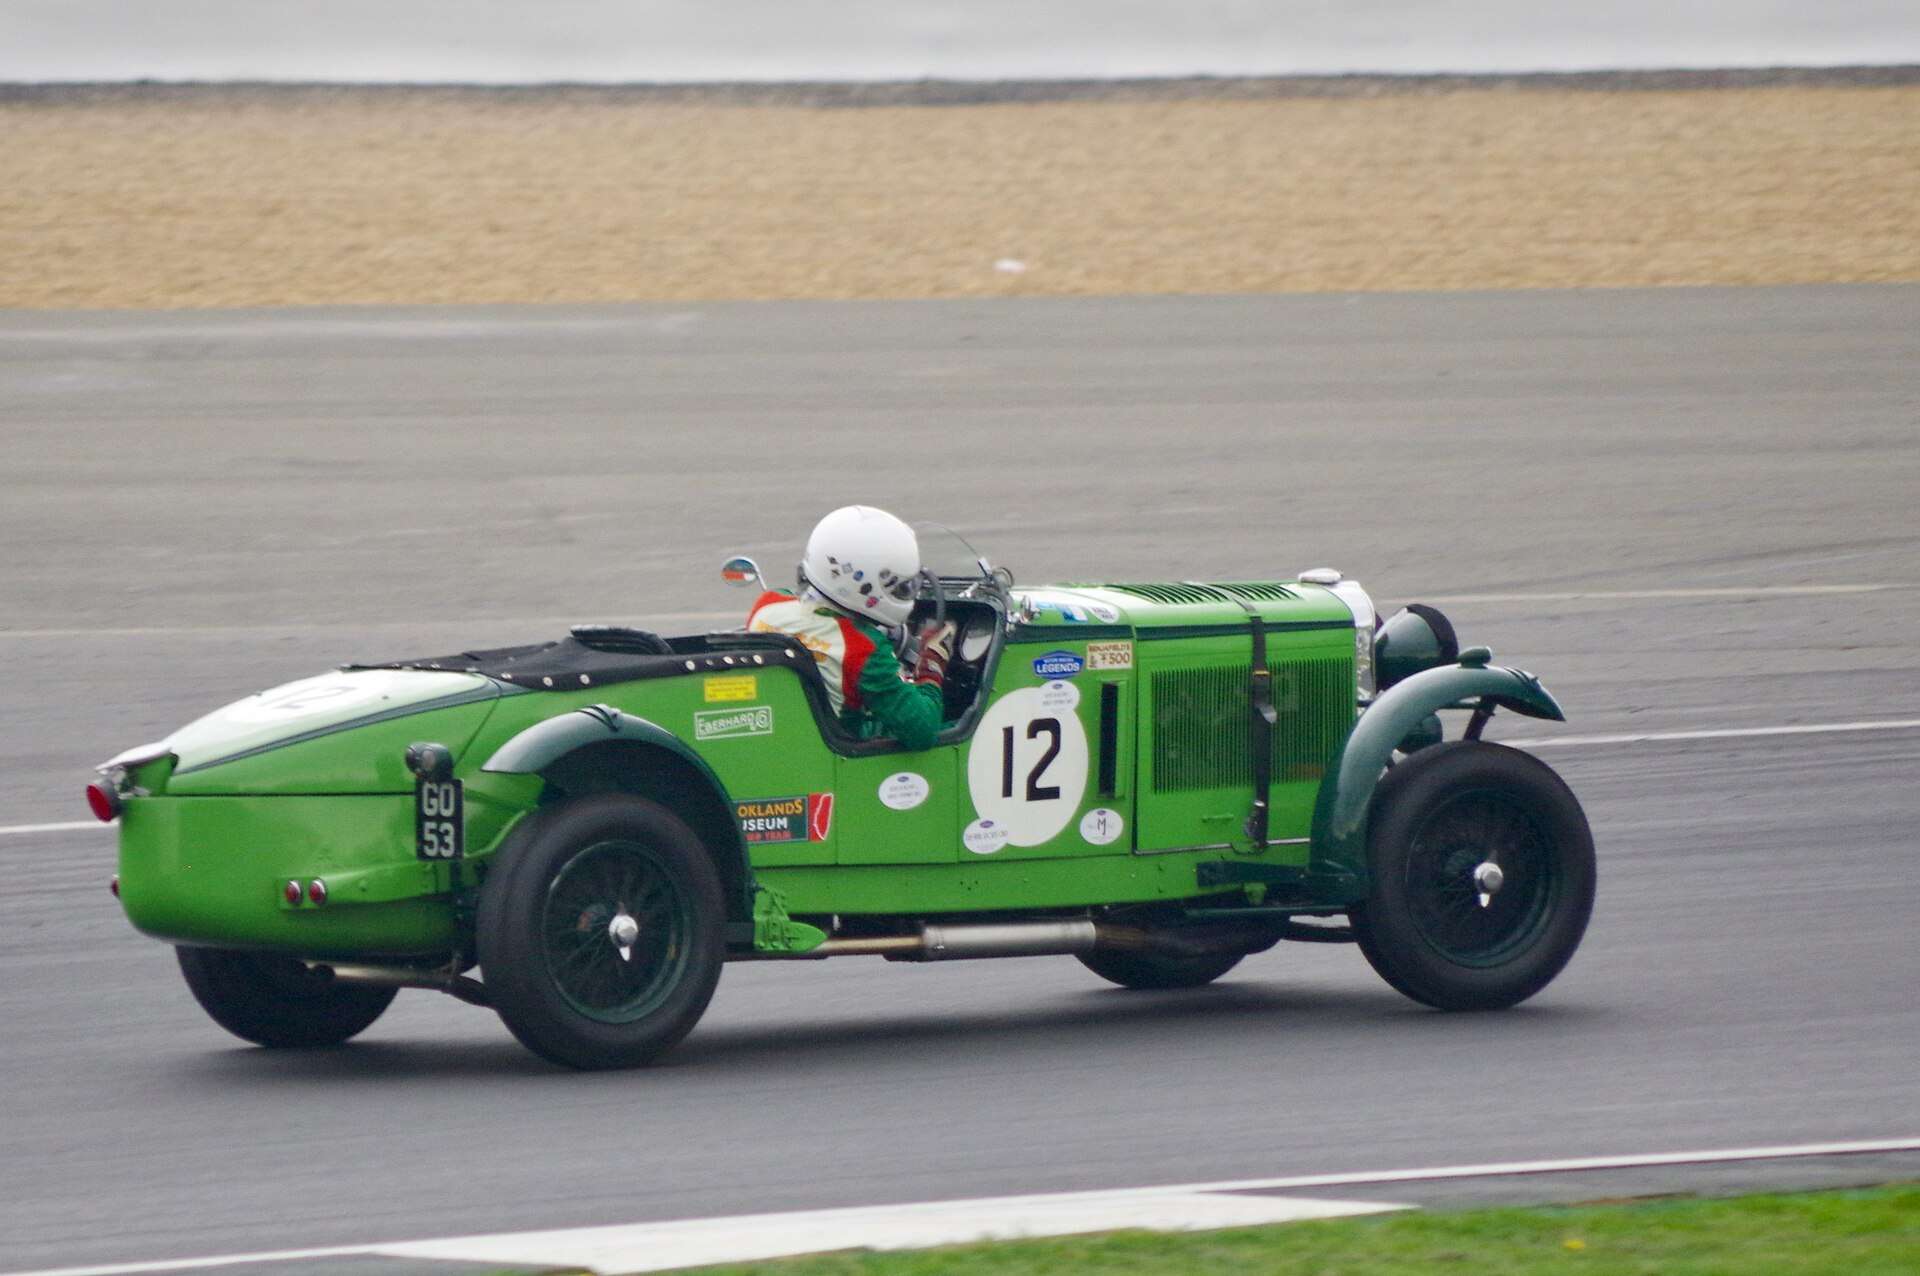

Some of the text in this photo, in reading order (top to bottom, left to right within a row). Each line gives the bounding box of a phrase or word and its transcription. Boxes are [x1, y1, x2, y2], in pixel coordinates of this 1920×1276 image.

[1036, 662, 1080, 673] LEGENDS
[1109, 652, 1130, 664] 500
[1001, 717, 1061, 802] 12
[422, 783, 455, 816] GO
[423, 822, 455, 857] 53
